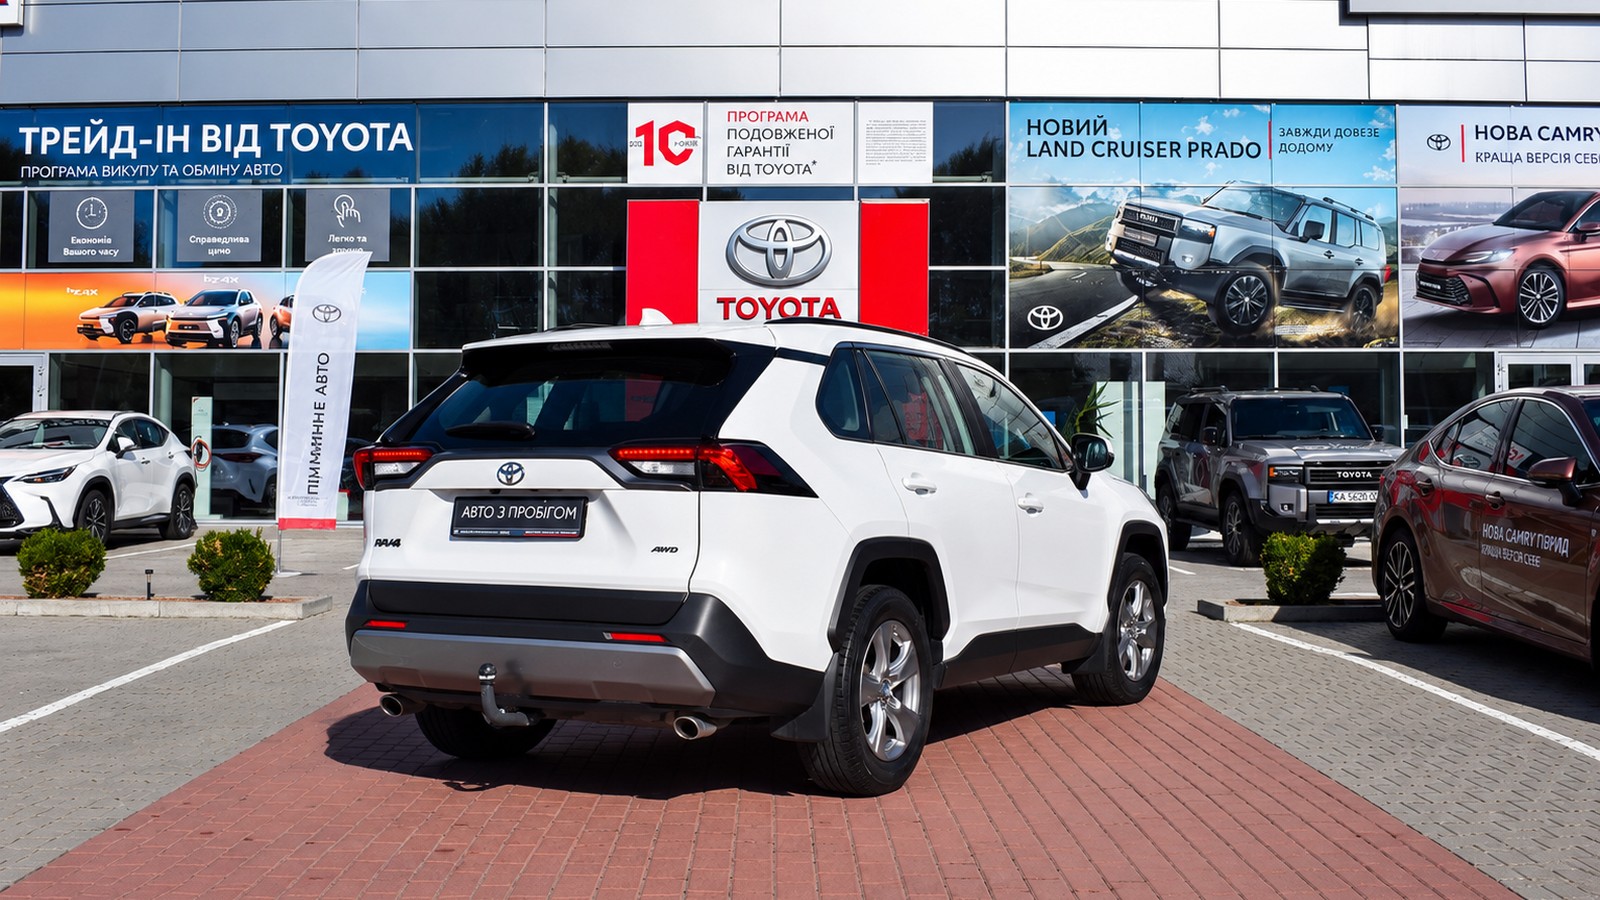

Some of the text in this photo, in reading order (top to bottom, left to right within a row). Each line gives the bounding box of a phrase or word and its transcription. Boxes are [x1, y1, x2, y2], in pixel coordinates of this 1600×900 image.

[727, 110, 809, 123] ПРОГРАМА
[1026, 115, 1108, 136] НОВИЙ
[1278, 127, 1380, 139] ЗАВЖДИ ДОВЕЗЕ
[1475, 124, 1533, 141] НОВА
[19, 119, 414, 159] ТРЕЙД-ІН ВІД TOYOTA
[727, 126, 835, 142] ПОДОВЖЕНОЇ
[727, 143, 791, 158] ГАРАНТІЇ
[1026, 140, 1262, 159] LAND CRUISER PRADO
[1278, 142, 1334, 154] ДОДОМУ
[1475, 152, 1600, 165] КРАЩА ВЕРСІЯ СЕБ
[20, 163, 283, 179] ПРОГРАМА ВИКУПУ ТА ОБМІНУ АВТО
[727, 163, 752, 177] ВІД
[716, 297, 842, 320] TOYOTA
[315, 352, 330, 396] АВТО
[461, 505, 495, 519] АВТО
[508, 503, 577, 520] ПРОБІГОМ
[373, 538, 402, 548] RAV4
[650, 546, 679, 554] AWD
